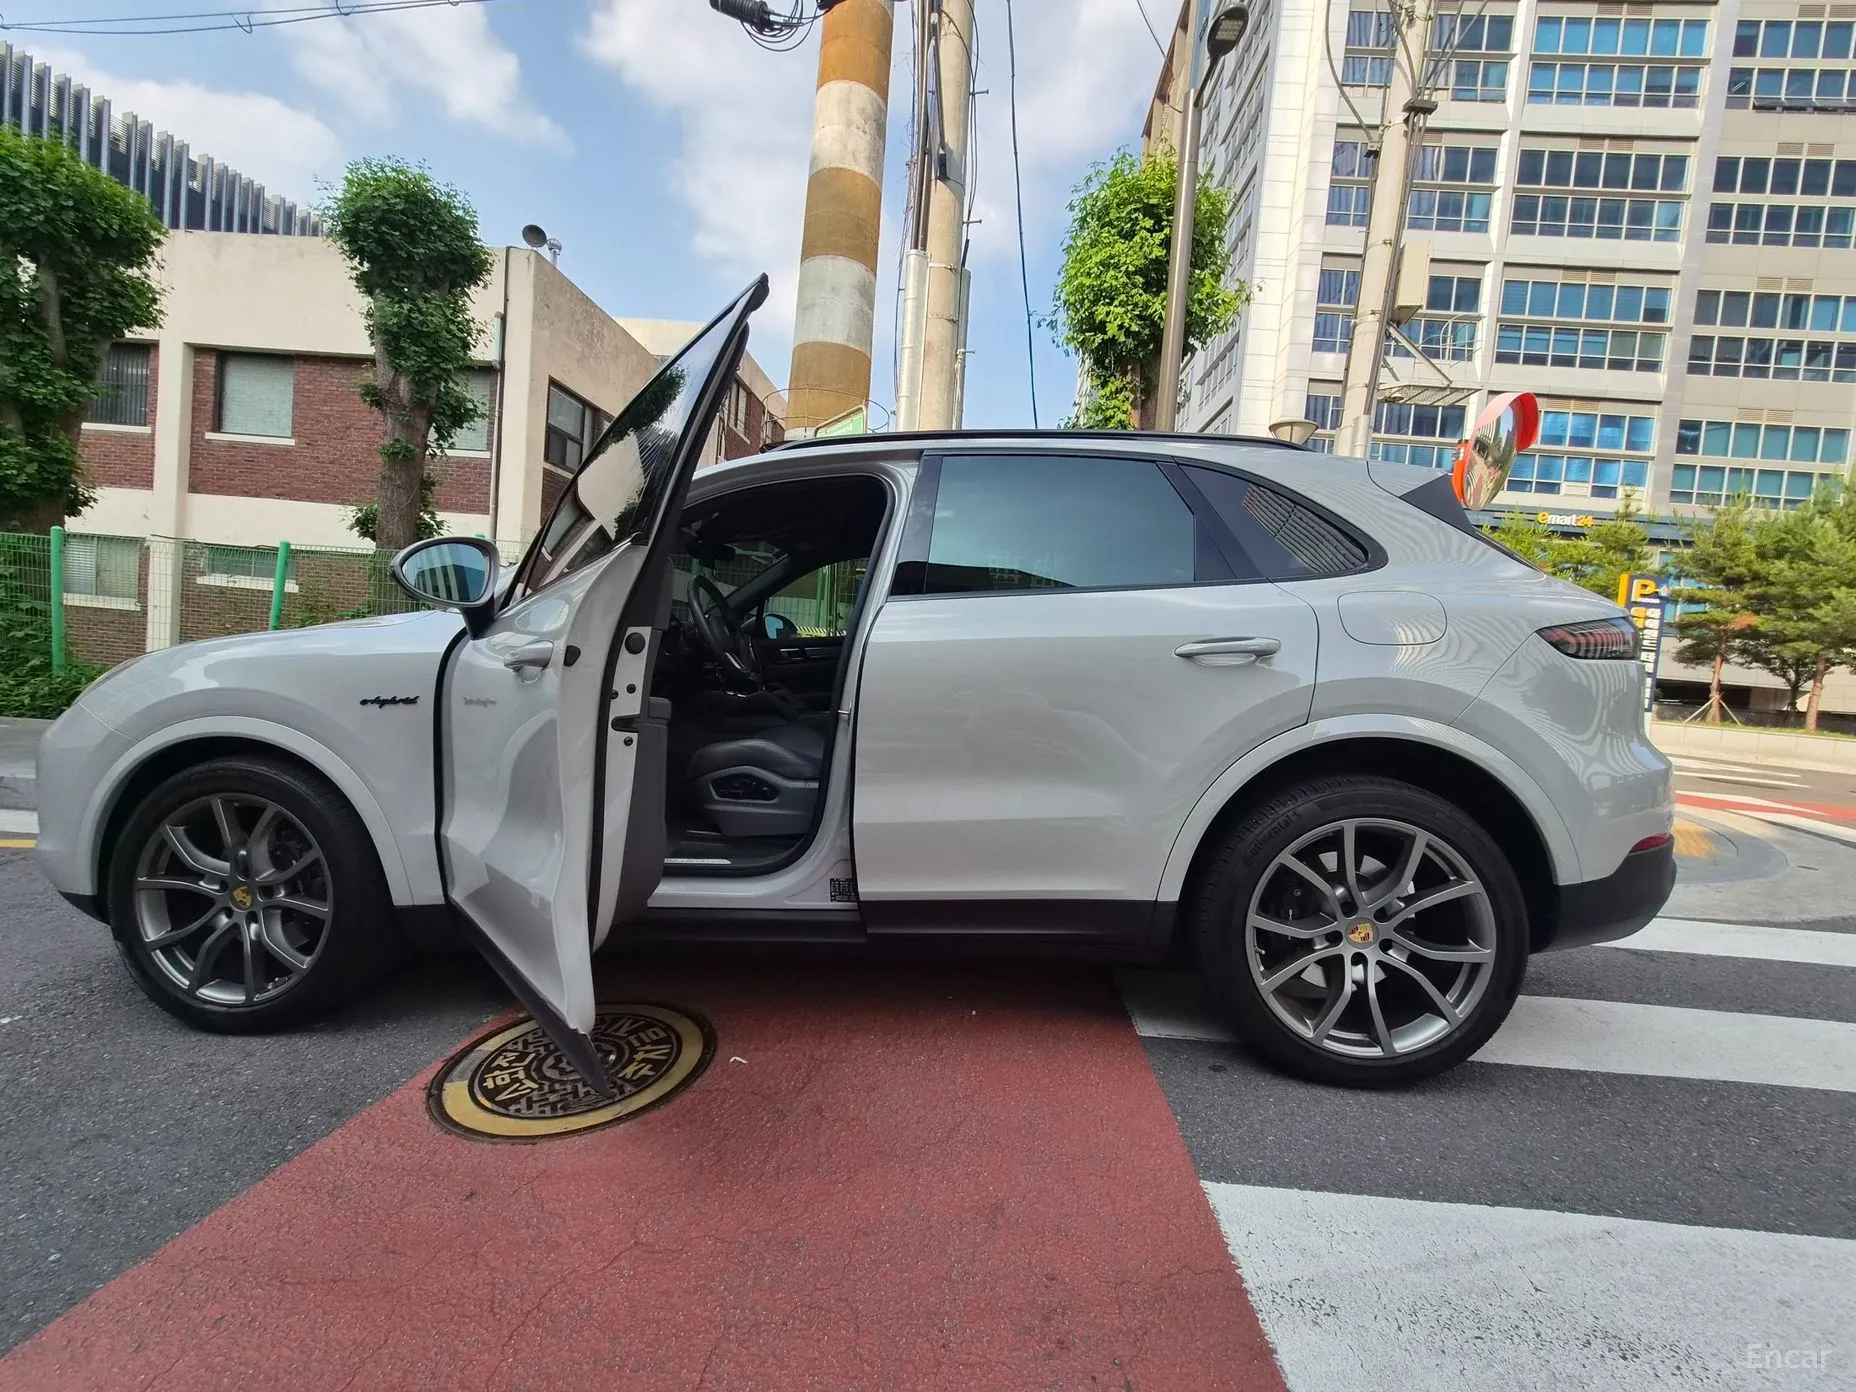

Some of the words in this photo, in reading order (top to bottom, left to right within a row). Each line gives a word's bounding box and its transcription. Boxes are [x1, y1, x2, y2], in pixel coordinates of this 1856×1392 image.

[1538, 512, 1596, 527] emart24
[1631, 579, 1657, 602] P
[482, 1052, 539, 1101] 소화전
